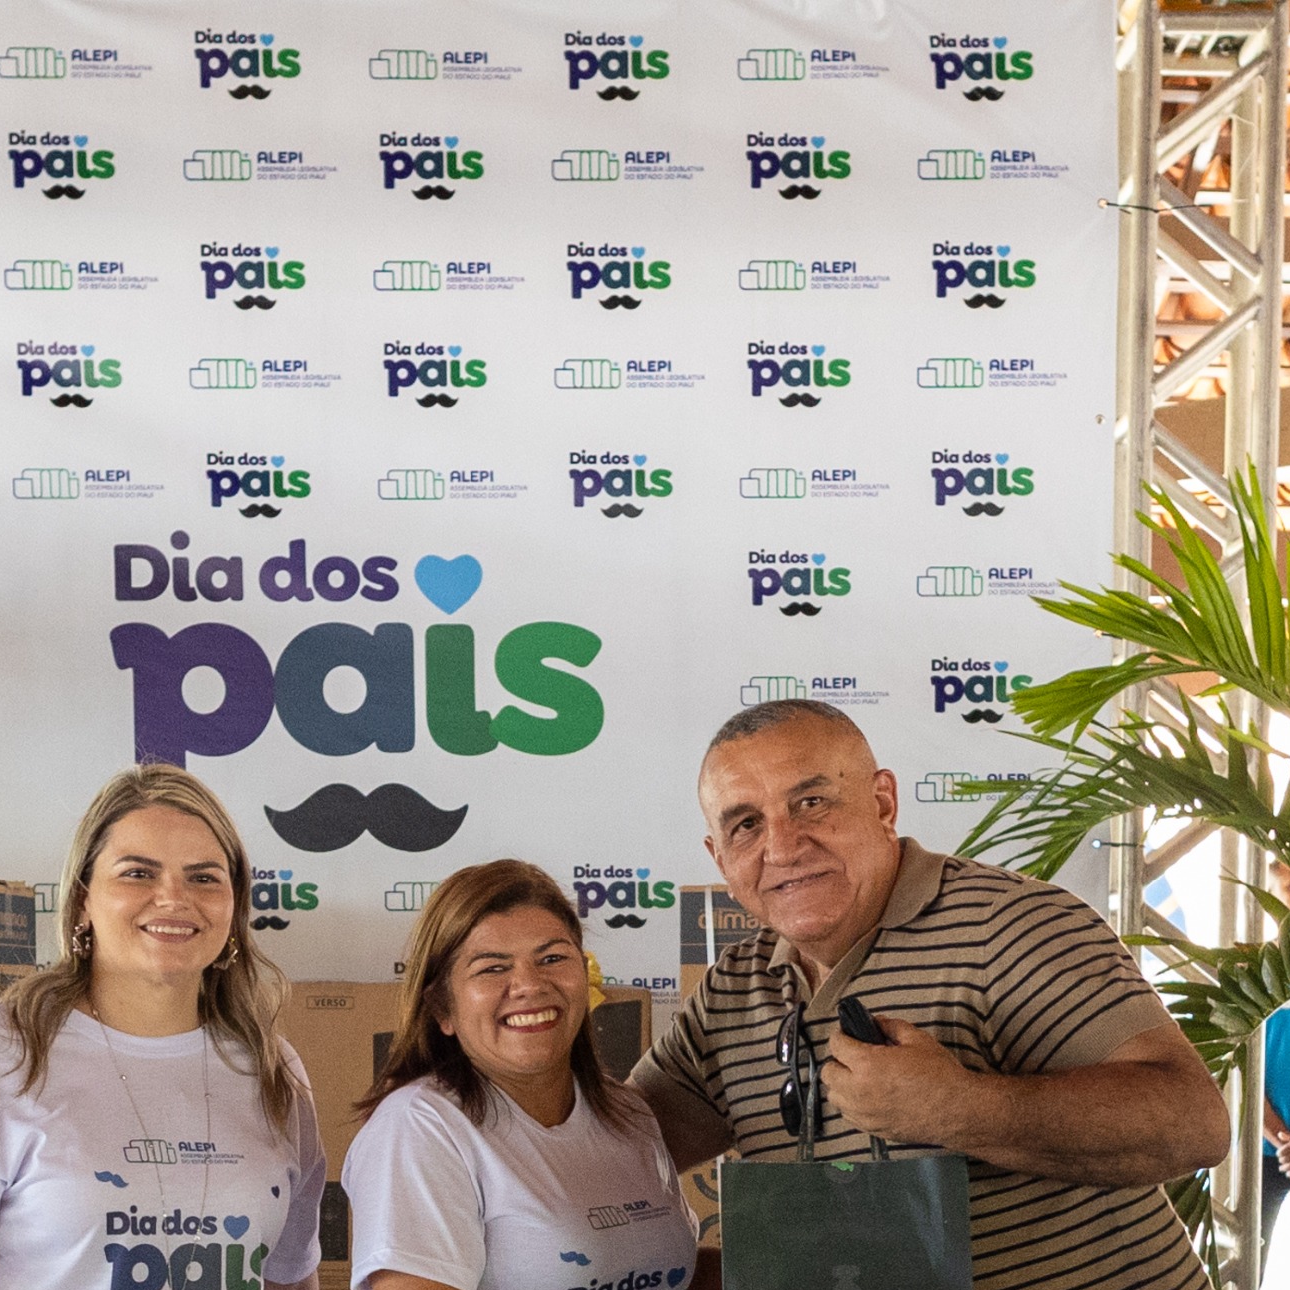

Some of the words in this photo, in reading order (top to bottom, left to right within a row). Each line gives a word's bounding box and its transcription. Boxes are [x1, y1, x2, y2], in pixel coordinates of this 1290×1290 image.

[194, 28, 223, 44] Dia
[226, 30, 256, 44] dos
[565, 30, 593, 46] Dia
[596, 32, 626, 46] dos
[929, 33, 957, 48] Dia
[959, 34, 989, 48] dos
[71, 49, 117, 61] ALEPI
[443, 52, 487, 64] ALEPI
[811, 50, 856, 62] ALEPI
[194, 48, 301, 89] pais
[564, 50, 670, 90] pais
[929, 50, 1034, 90] pais
[8, 130, 37, 146] Dia
[40, 132, 70, 146] dos
[380, 131, 408, 147] Dia
[410, 133, 441, 147] dos
[747, 131, 775, 147] Dia
[778, 133, 808, 147] dos
[257, 151, 302, 164] ALEPI
[625, 151, 670, 164] ALEPI
[991, 150, 1035, 162] ALEPI
[8, 149, 115, 188] pais
[379, 150, 484, 189] pais
[746, 150, 851, 189] pais
[200, 241, 228, 257] Dia
[231, 243, 261, 257] dos
[567, 241, 595, 257] Dia
[598, 243, 628, 257] dos
[933, 240, 960, 256] Dia
[963, 242, 993, 256] dos
[78, 262, 123, 274] ALEPI
[447, 262, 490, 274] ALEPI
[812, 261, 856, 273] ALEPI
[200, 260, 306, 299] pais
[566, 261, 671, 299] pais
[932, 259, 1036, 298] pais
[17, 340, 44, 355] Dia
[48, 342, 77, 355] dos
[384, 340, 411, 355] Dia
[415, 342, 444, 356] dos
[748, 340, 775, 355] Dia
[778, 342, 808, 355] dos
[262, 360, 307, 372] ALEPI
[627, 360, 671, 372] ALEPI
[989, 359, 1033, 371] ALEPI
[16, 359, 122, 397] pais
[383, 359, 487, 397] pais
[747, 358, 851, 397] pais
[207, 451, 234, 465] Dia
[238, 453, 267, 466] dos
[570, 449, 597, 464] Dia
[600, 451, 629, 465] dos
[932, 449, 959, 464] Dia
[962, 450, 991, 463] dos
[85, 470, 130, 482] ALEPI
[450, 471, 493, 482] ALEPI
[812, 470, 856, 481] ALEPI
[206, 469, 311, 507] pais
[569, 469, 673, 507] pais
[931, 467, 1034, 506] pais
[749, 549, 776, 564] Dia
[779, 550, 808, 564] dos
[114, 530, 244, 601] Dia
[259, 539, 399, 602] dos
[989, 568, 1032, 579] ALEPI
[748, 567, 851, 606] pais
[931, 656, 959, 671] Dia
[961, 658, 991, 671] dos
[812, 678, 856, 689] ALEPI
[109, 621, 605, 770] pais
[574, 864, 602, 878] Dia
[604, 865, 633, 878] dos
[251, 882, 319, 911] ais
[573, 881, 676, 918] pais
[697, 909, 759, 930] clima
[632, 978, 676, 989] ALEPI
[314, 999, 346, 1007] VERSO
[179, 1142, 216, 1152] ALEPI
[106, 1205, 157, 1236] Dia
[162, 1209, 217, 1236] dos
